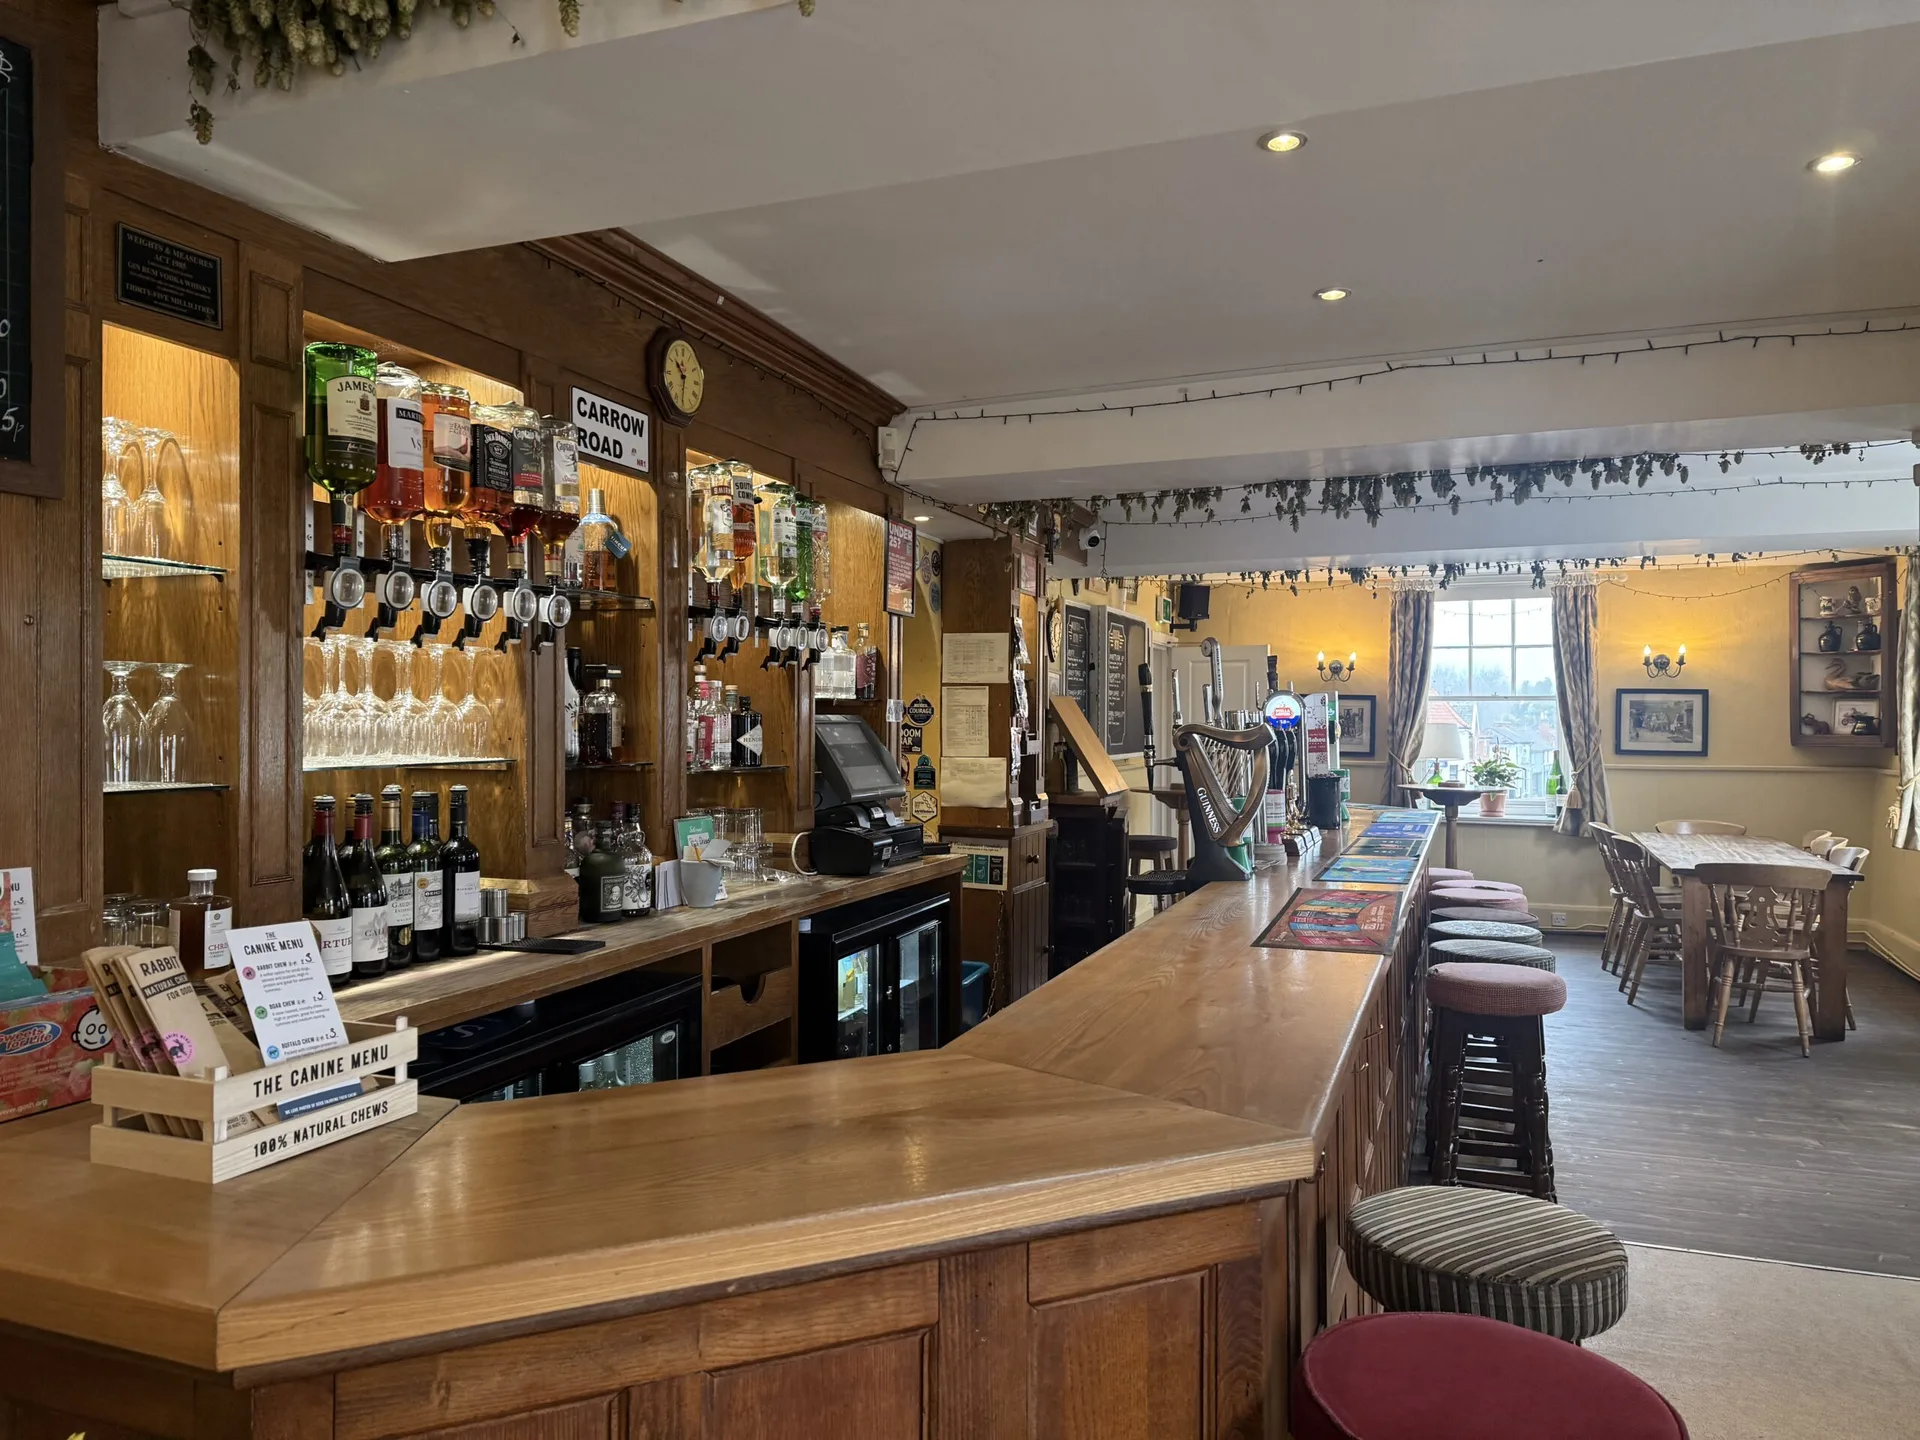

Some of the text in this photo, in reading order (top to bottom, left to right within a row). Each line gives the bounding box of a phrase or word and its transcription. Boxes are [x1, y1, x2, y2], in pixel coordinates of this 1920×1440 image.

[126, 232, 163, 252] WEIGHTS
[164, 246, 171, 255] &
[172, 248, 214, 269] MEASURES
[154, 254, 170, 265] ACT
[127, 261, 141, 270] GIN
[141, 265, 159, 277] RUM
[159, 271, 184, 284] VODKA
[576, 396, 645, 438] CARROW
[577, 427, 624, 460] ROAD
[889, 522, 913, 542] UNDER
[1197, 787, 1222, 834] GUINNESS
[265, 931, 276, 939] THE
[243, 938, 304, 956] CANINE MENU
[139, 955, 182, 977] RABBIT
[144, 977, 174, 998] NATURAL
[166, 990, 180, 1001] FOR
[253, 1074, 283, 1098] THE
[290, 1057, 344, 1087] CANINE
[350, 1044, 389, 1070] MENU
[253, 1101, 389, 1158] 100% NATURAL CHEWS
